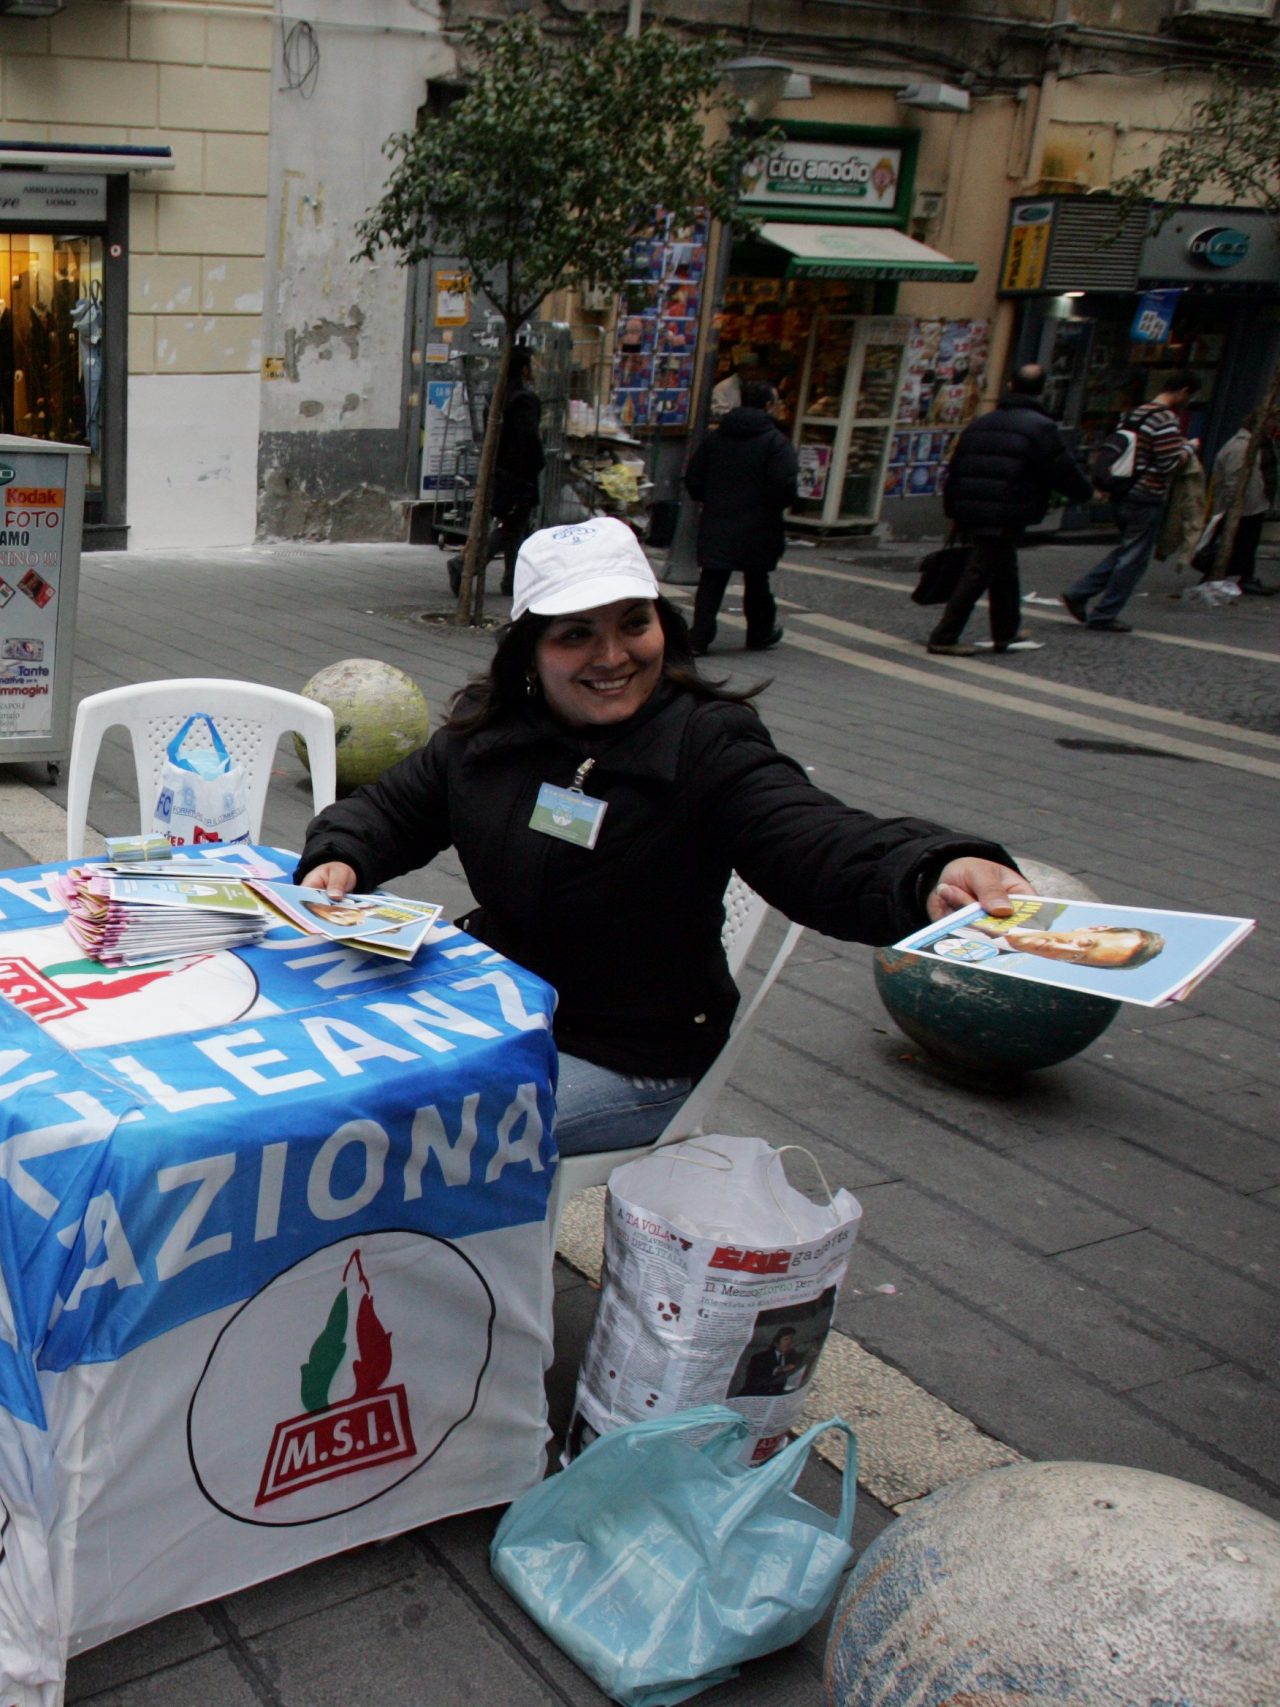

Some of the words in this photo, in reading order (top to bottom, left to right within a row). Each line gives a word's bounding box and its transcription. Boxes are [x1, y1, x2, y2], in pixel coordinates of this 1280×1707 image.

[769, 153, 803, 180] ciro
[805, 156, 871, 182] amodio
[6, 488, 57, 504] Kodak
[5, 511, 60, 528] FOTO
[18, 665, 49, 677] Tante
[279, 1410, 391, 1476] M.S.I.
